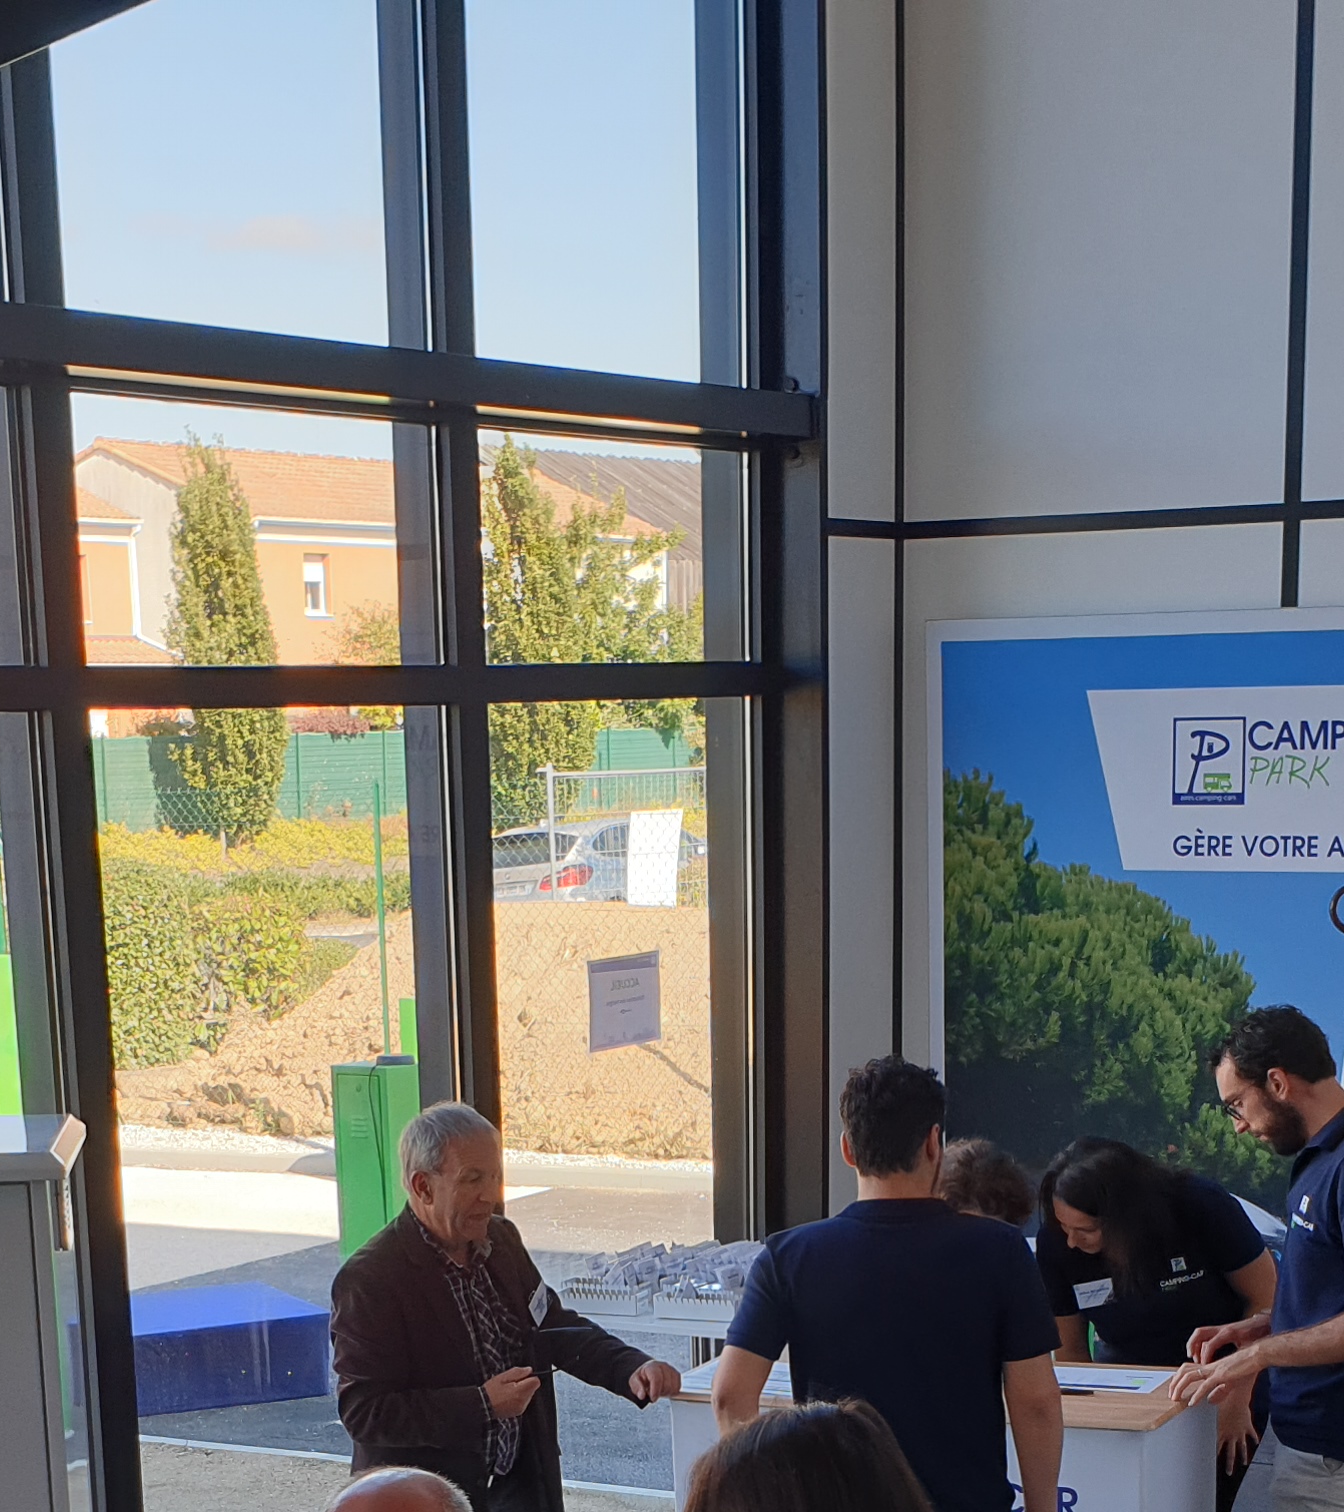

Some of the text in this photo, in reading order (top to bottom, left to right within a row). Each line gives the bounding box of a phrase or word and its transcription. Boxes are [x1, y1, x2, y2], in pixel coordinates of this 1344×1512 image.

[1249, 756, 1330, 788] PARK
[1172, 828, 1233, 858] GÈRE
[1241, 835, 1319, 858] VOTRE
